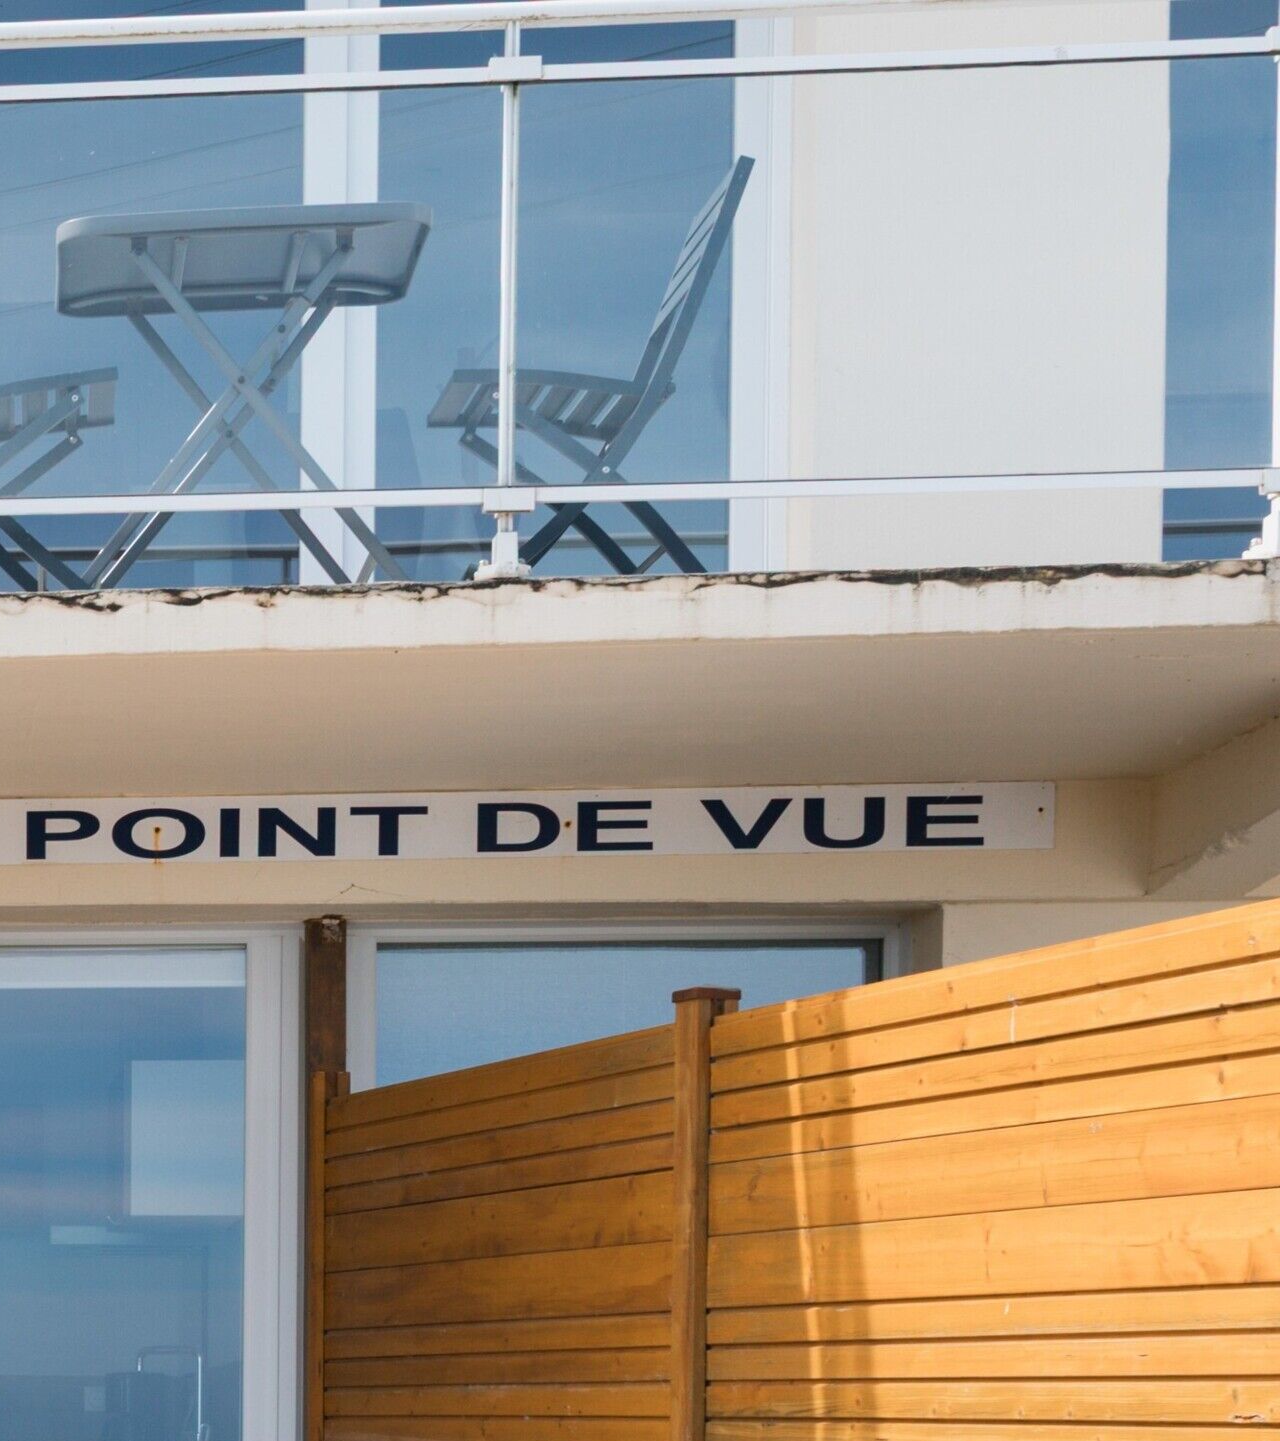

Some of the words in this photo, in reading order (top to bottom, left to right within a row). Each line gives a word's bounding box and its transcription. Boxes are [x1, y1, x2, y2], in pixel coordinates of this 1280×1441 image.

[25, 804, 430, 861] POINT
[475, 799, 655, 854] DE
[697, 793, 986, 851] VUE
